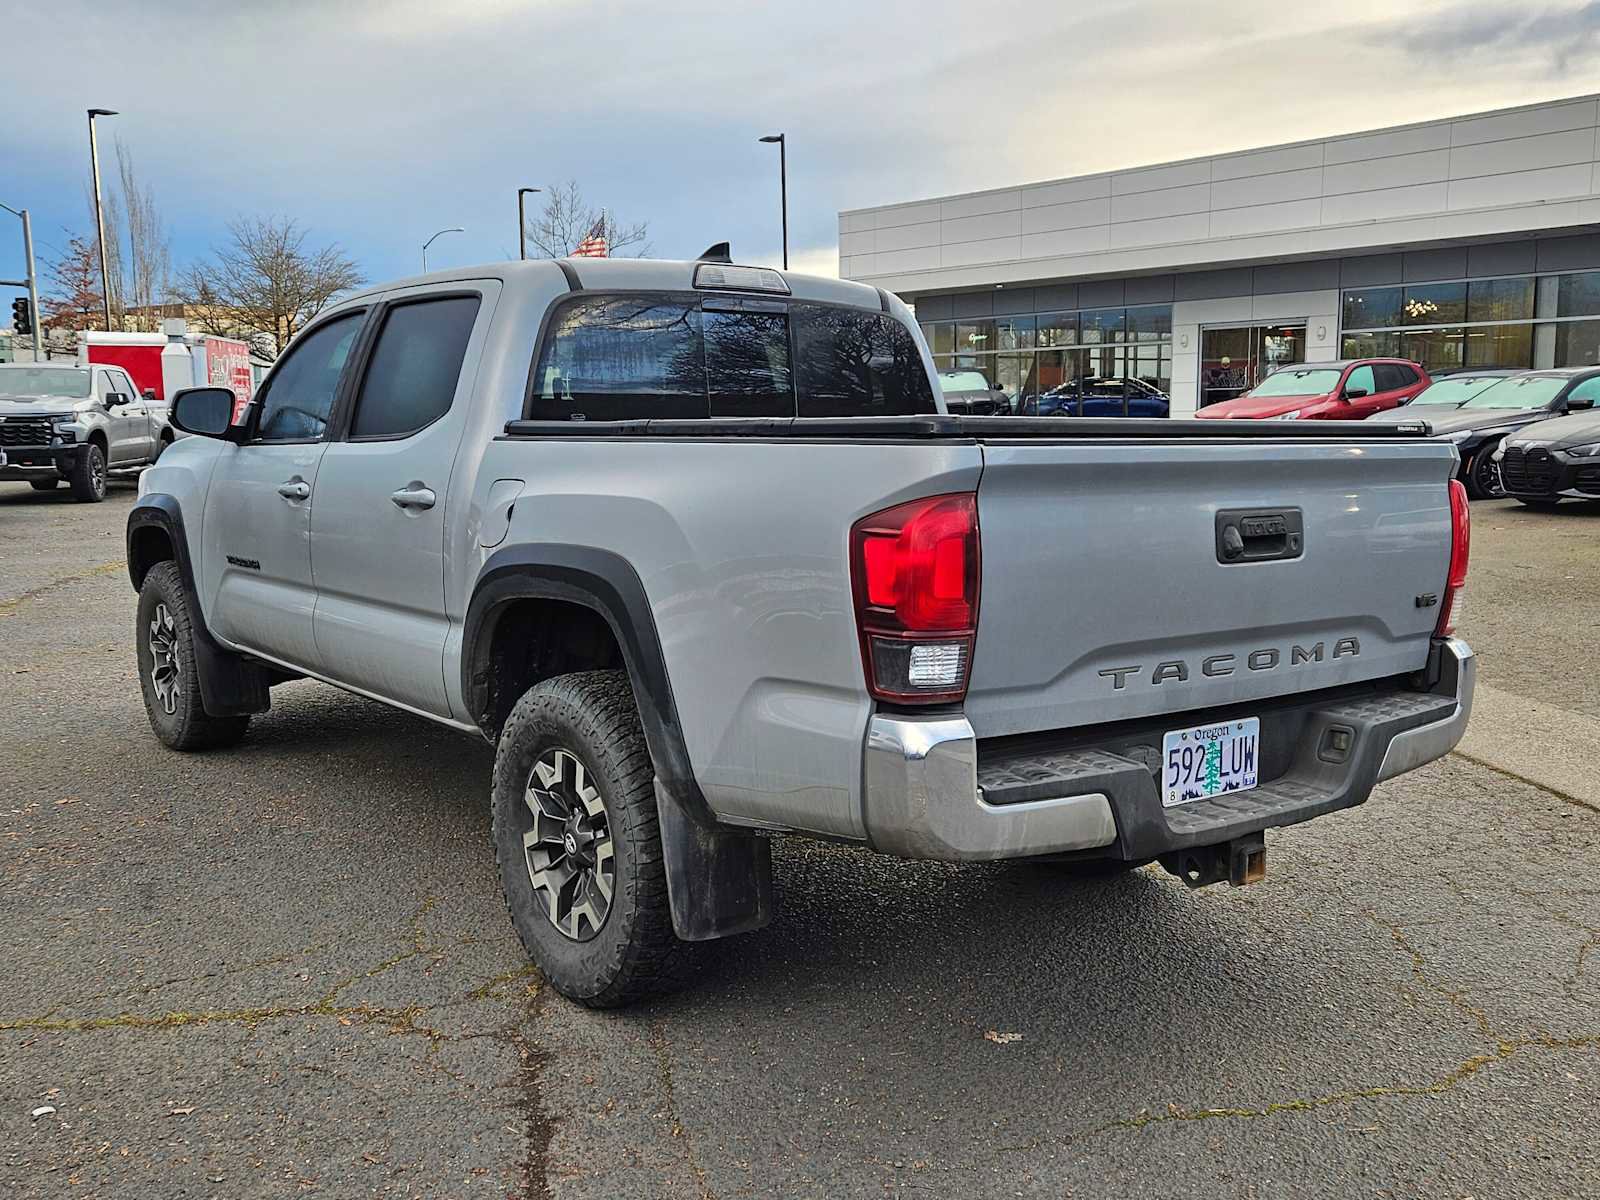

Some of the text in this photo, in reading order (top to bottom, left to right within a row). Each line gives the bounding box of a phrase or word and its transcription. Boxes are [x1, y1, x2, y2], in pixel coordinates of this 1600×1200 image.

[1098, 636, 1361, 690] TACOMA
[1194, 726, 1229, 741] Oregon
[1168, 734, 1255, 788] 592 LUW
